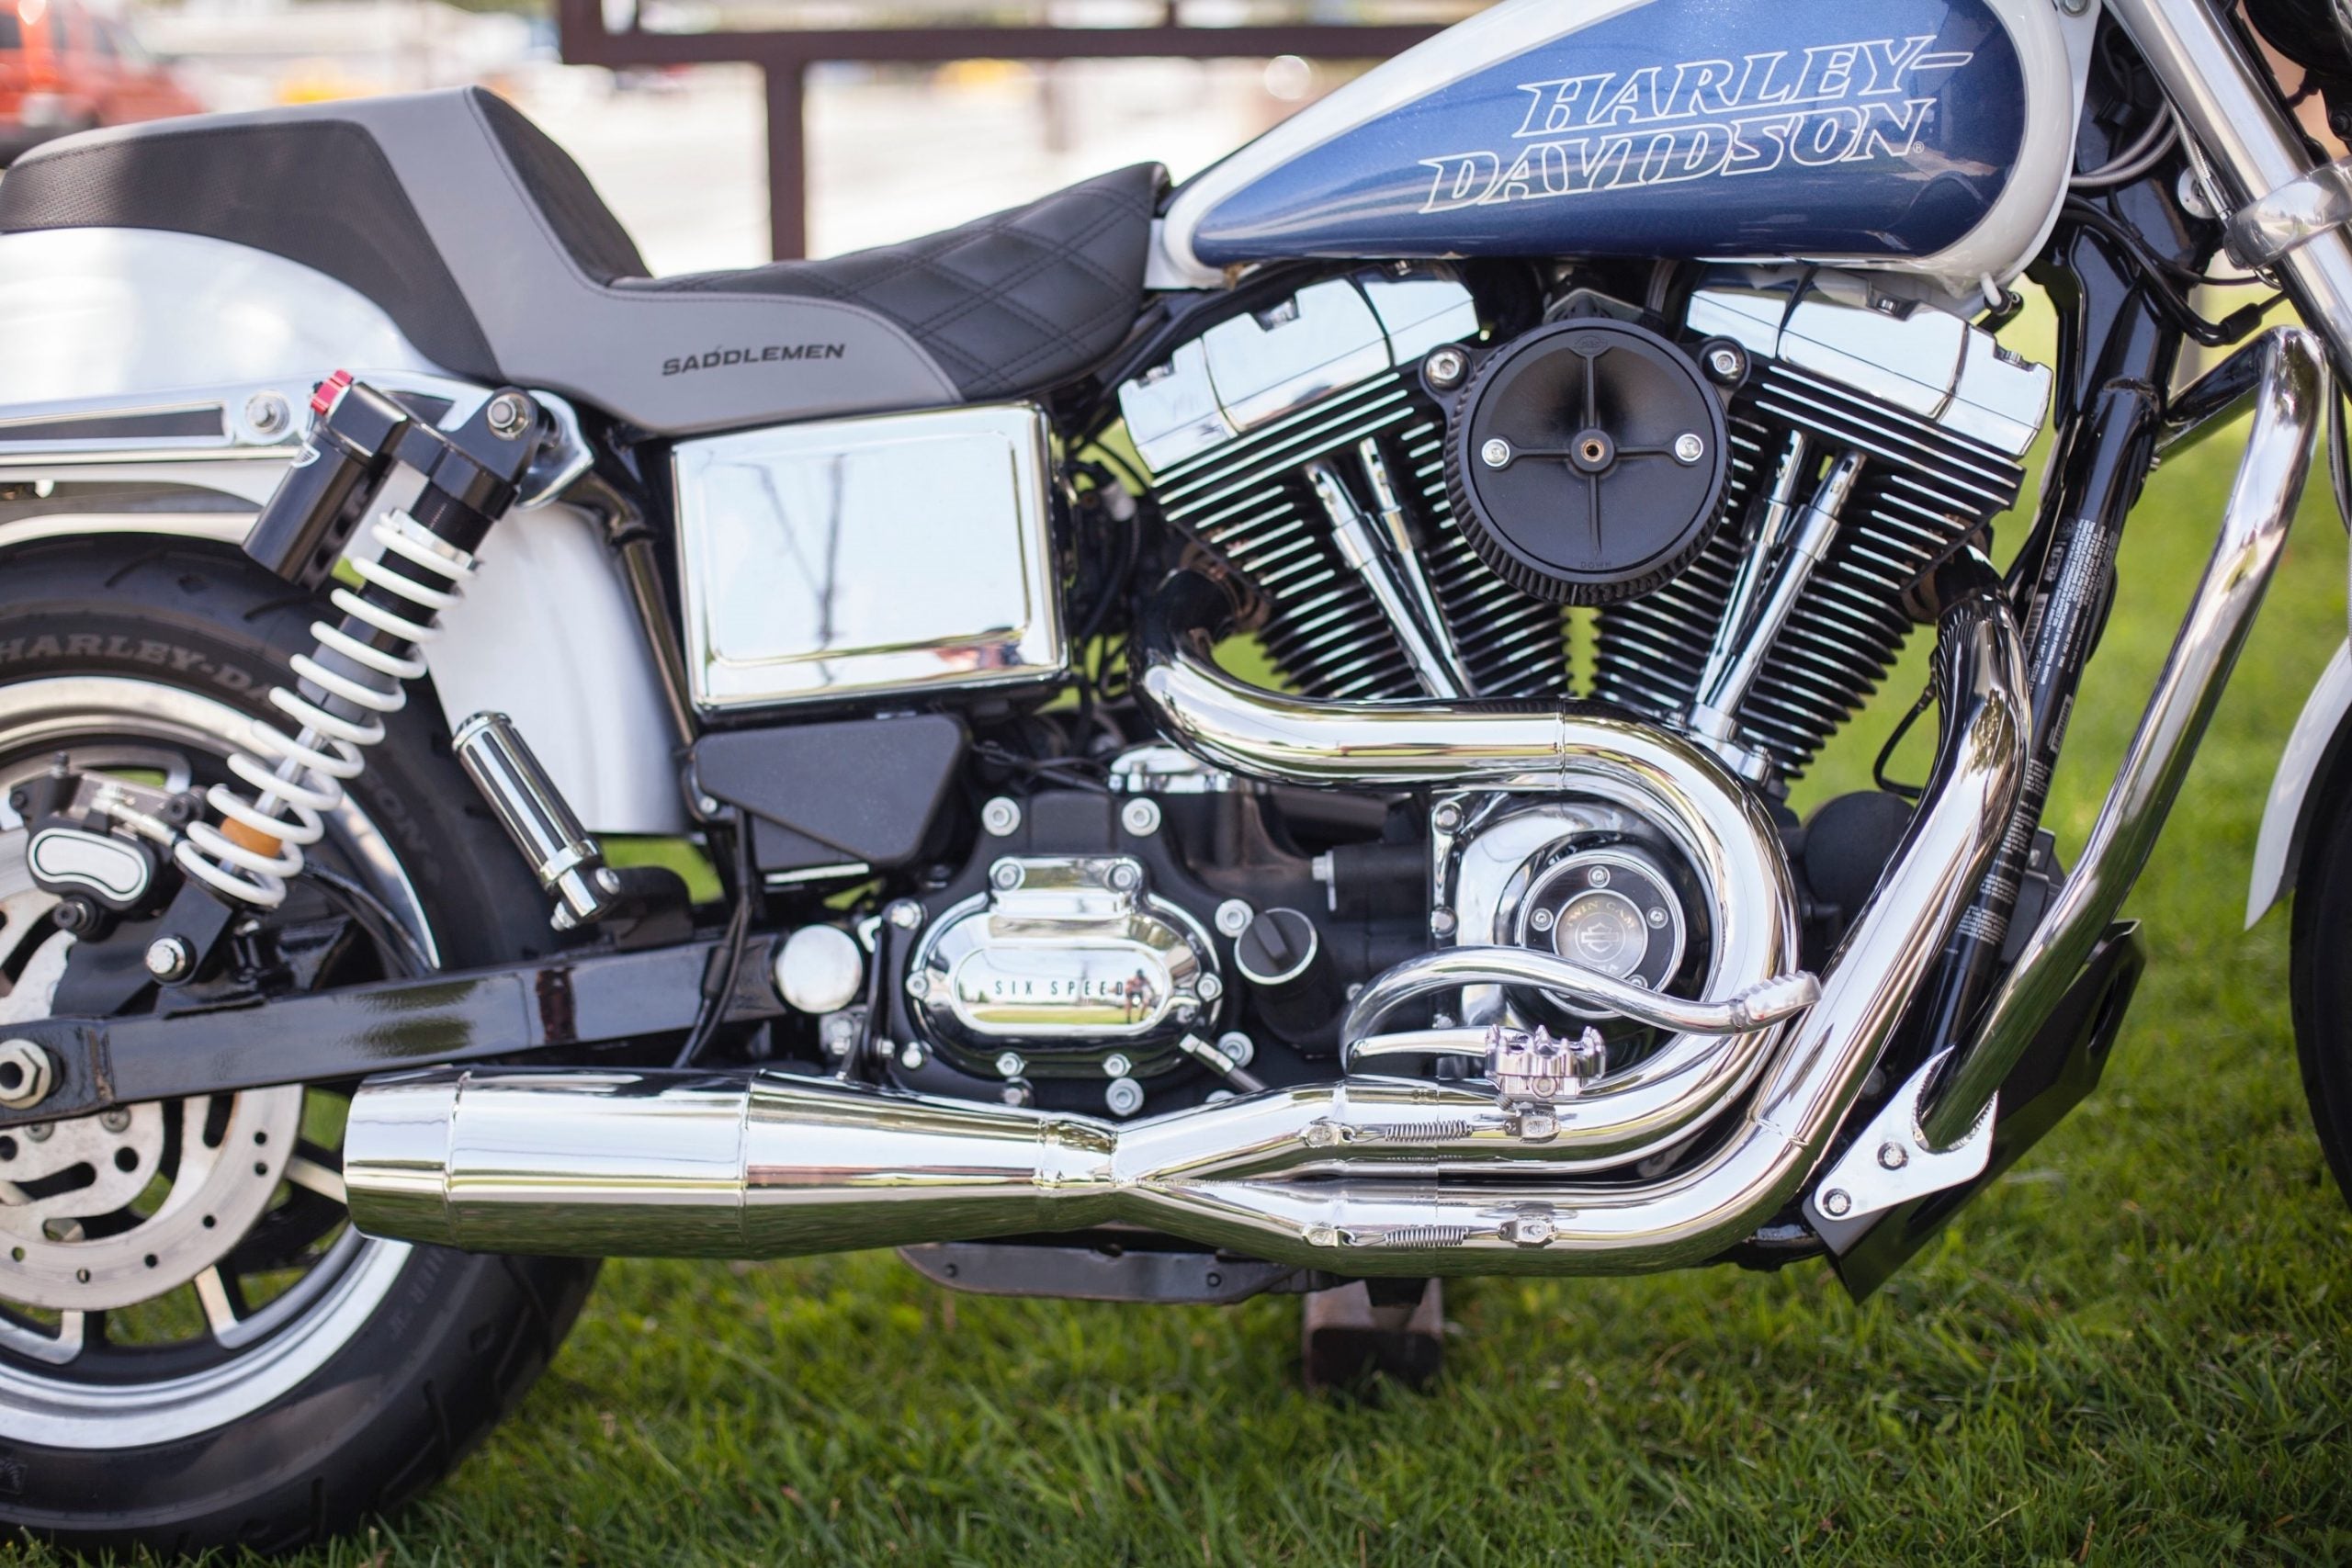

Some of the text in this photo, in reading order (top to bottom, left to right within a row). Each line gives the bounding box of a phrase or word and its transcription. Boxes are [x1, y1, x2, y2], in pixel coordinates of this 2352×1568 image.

[1418, 98, 1937, 213] DAVIDSON
[662, 344, 846, 376] SADDLEMEN
[1566, 901, 1636, 930] TWIN CAM
[995, 979, 1124, 996] SIX SPEED
